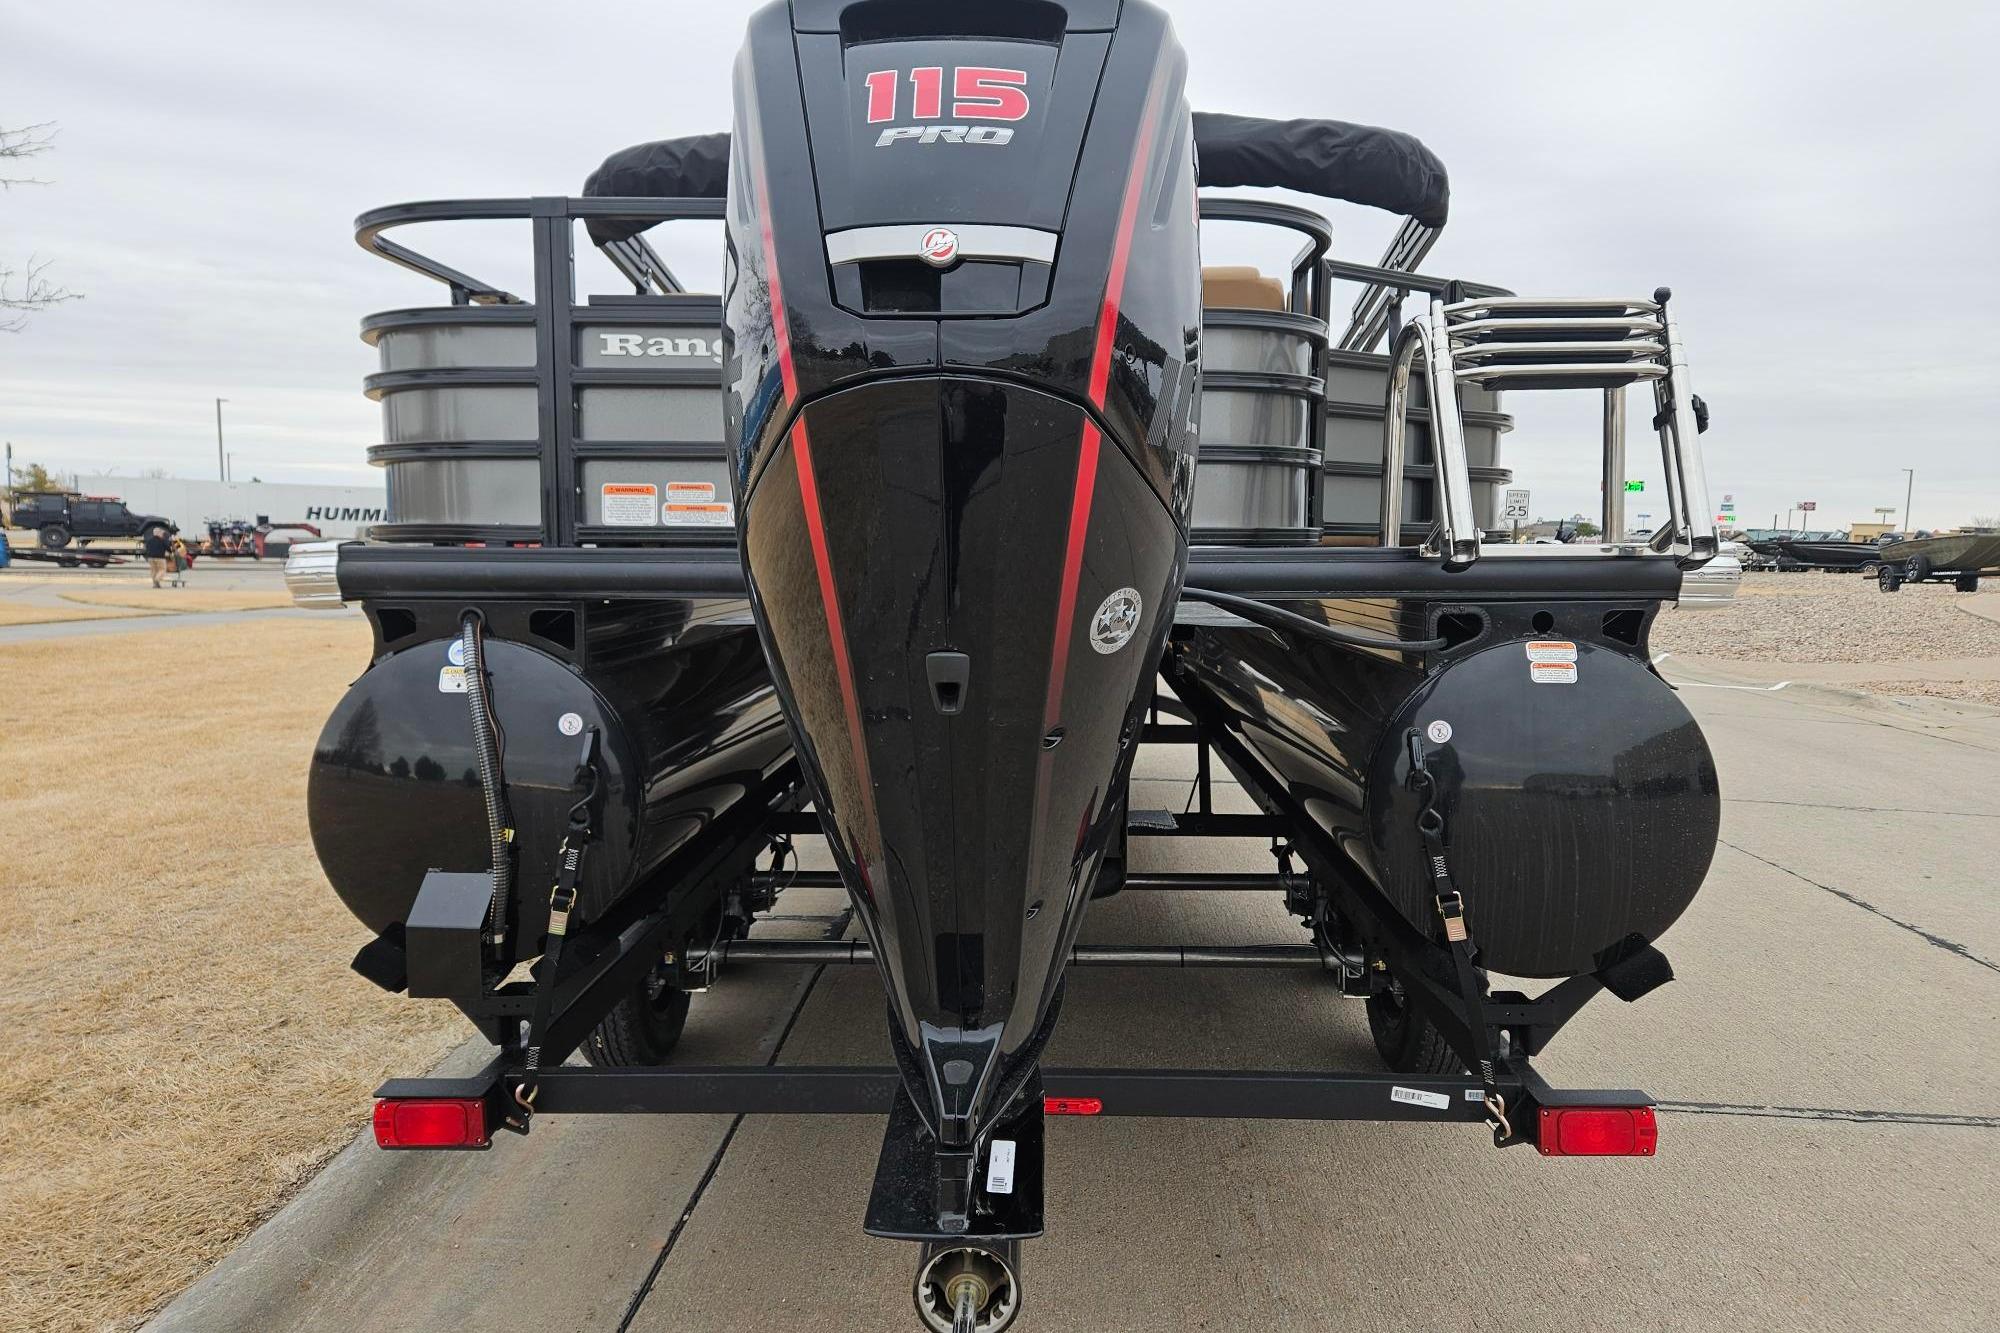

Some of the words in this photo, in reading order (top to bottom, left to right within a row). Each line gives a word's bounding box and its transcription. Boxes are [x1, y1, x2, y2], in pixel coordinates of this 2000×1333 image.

[865, 66, 1029, 123] 115
[875, 125, 1015, 147] PRO
[1507, 505, 1527, 517] 25
